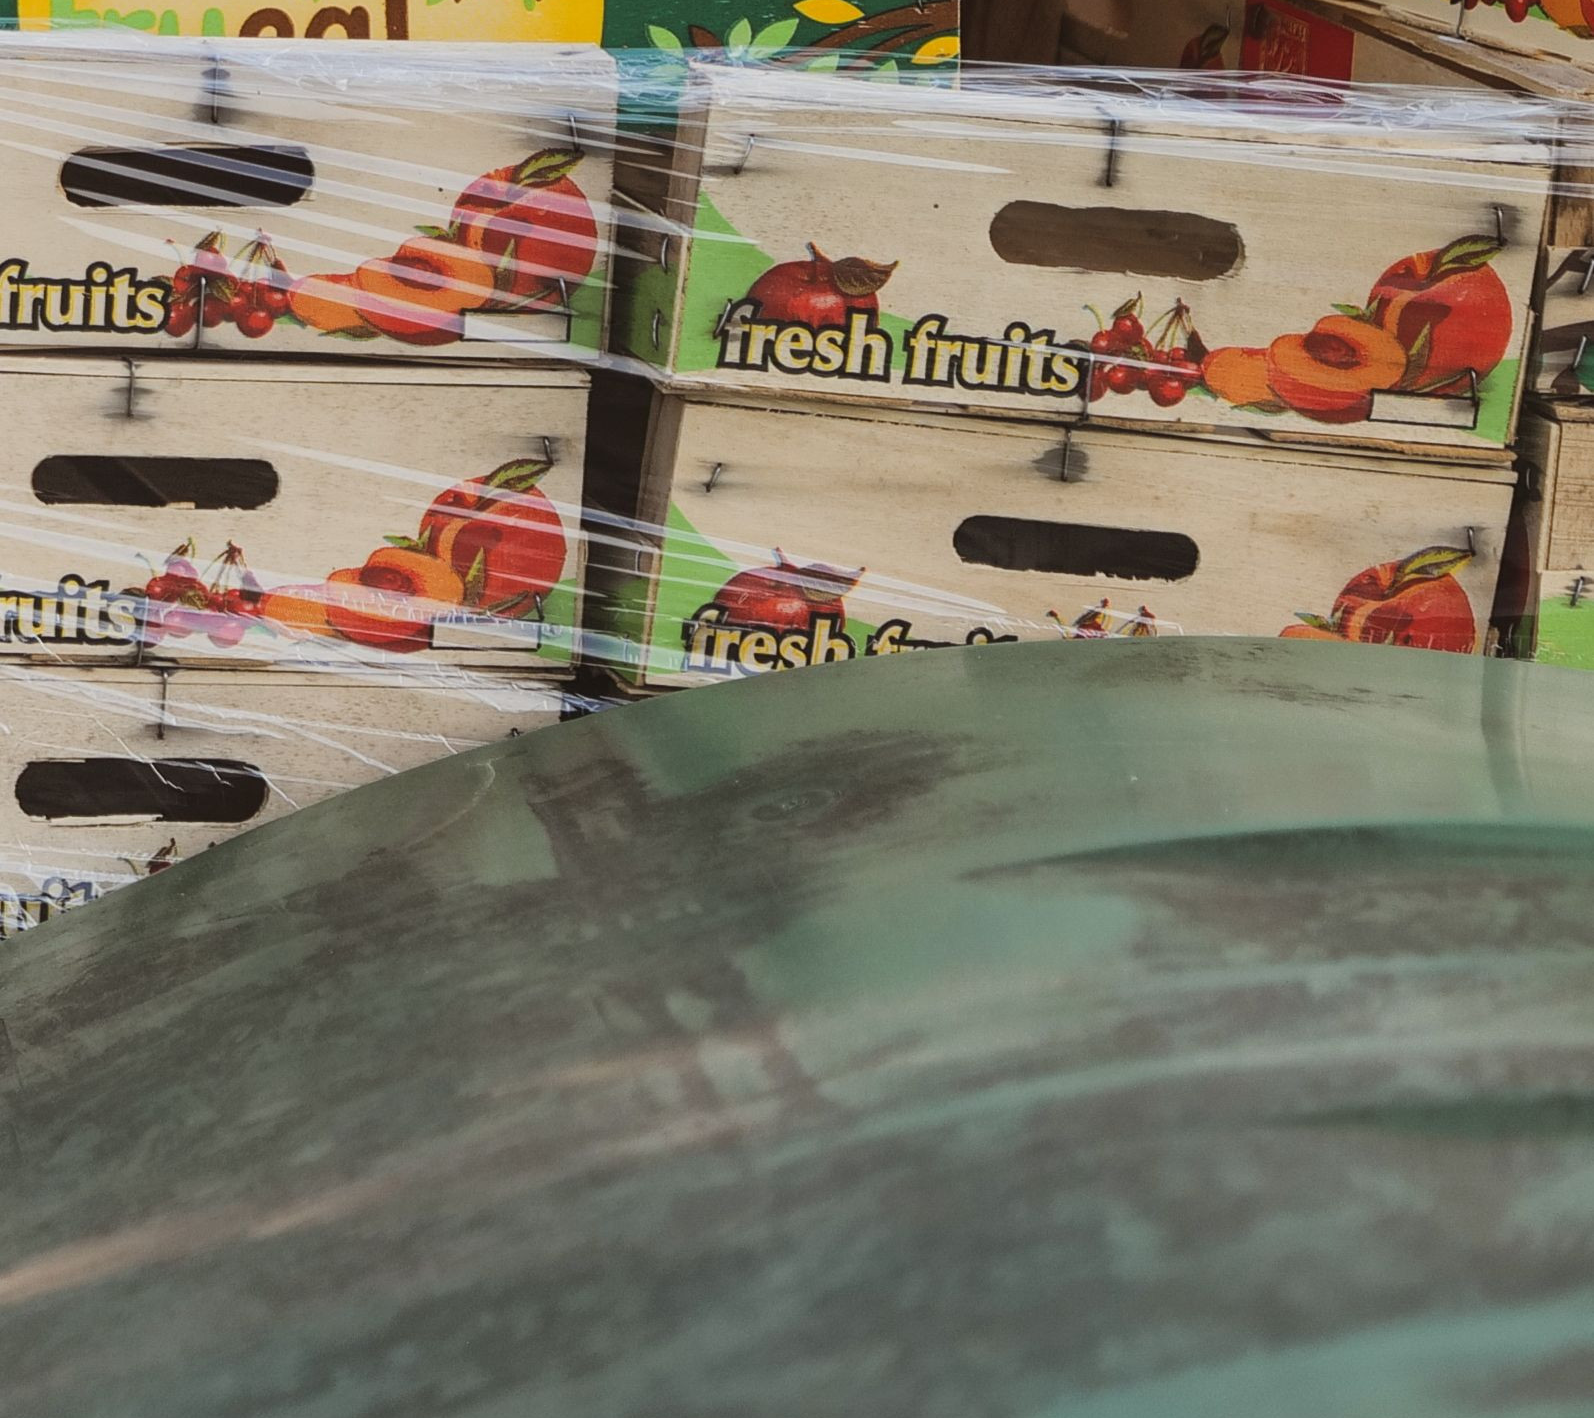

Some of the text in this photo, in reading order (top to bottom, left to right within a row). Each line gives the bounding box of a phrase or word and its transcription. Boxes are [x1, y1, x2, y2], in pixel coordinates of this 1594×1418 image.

[719, 297, 1090, 395] fresh fruits
[682, 602, 856, 673] fresh
